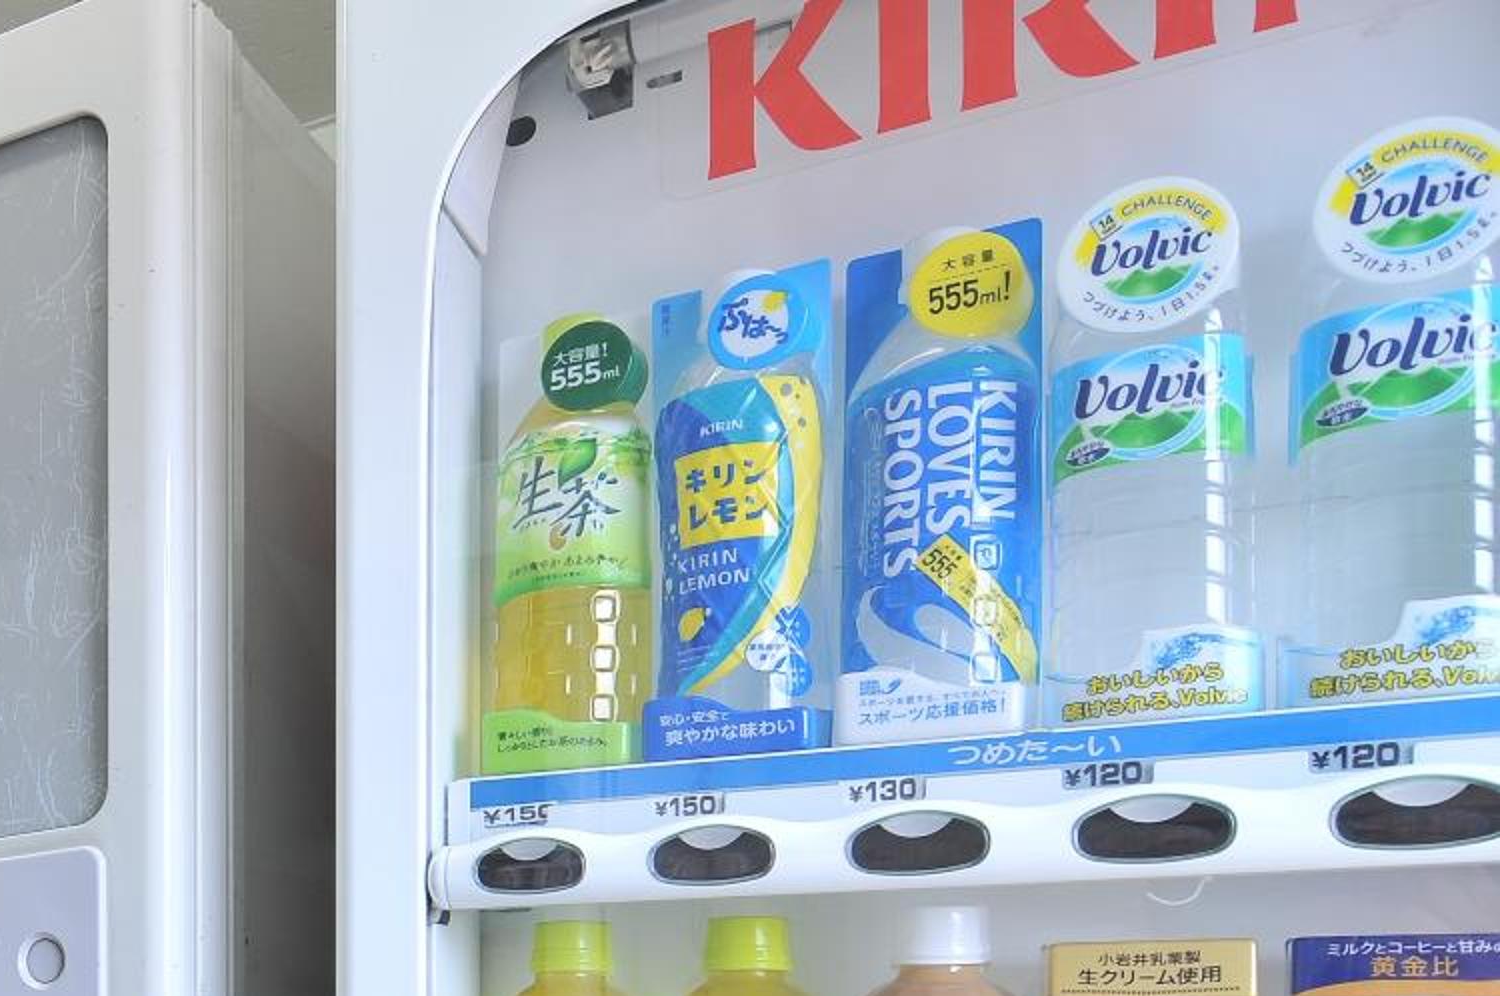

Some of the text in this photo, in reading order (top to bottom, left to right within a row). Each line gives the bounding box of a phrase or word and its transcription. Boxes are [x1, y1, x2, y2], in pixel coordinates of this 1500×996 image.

[708, 0, 1298, 181] KIR
[1381, 138, 1489, 163] CHALLENGE
[1121, 194, 1213, 221] CHALLENGE
[1350, 170, 1492, 227] Volvic
[1091, 226, 1213, 276] Volvic
[1074, 361, 1223, 420] Volvic
[700, 419, 744, 437] KIRIN
[926, 381, 973, 535] LOVES
[979, 381, 1017, 520] KIRIN
[685, 459, 767, 493] キリン
[882, 389, 924, 577] SPORTS
[689, 495, 768, 530] レモン
[678, 568, 750, 596] LEMON
[1087, 662, 1224, 694] おいしいから
[1310, 742, 1400, 771] ¥120
[1064, 761, 1143, 788] ¥120
[849, 778, 916, 803] ¥130
[655, 796, 714, 817] ¥150
[1078, 966, 1222, 987] 生クリーム使用
[1371, 955, 1459, 977] 黄金比
